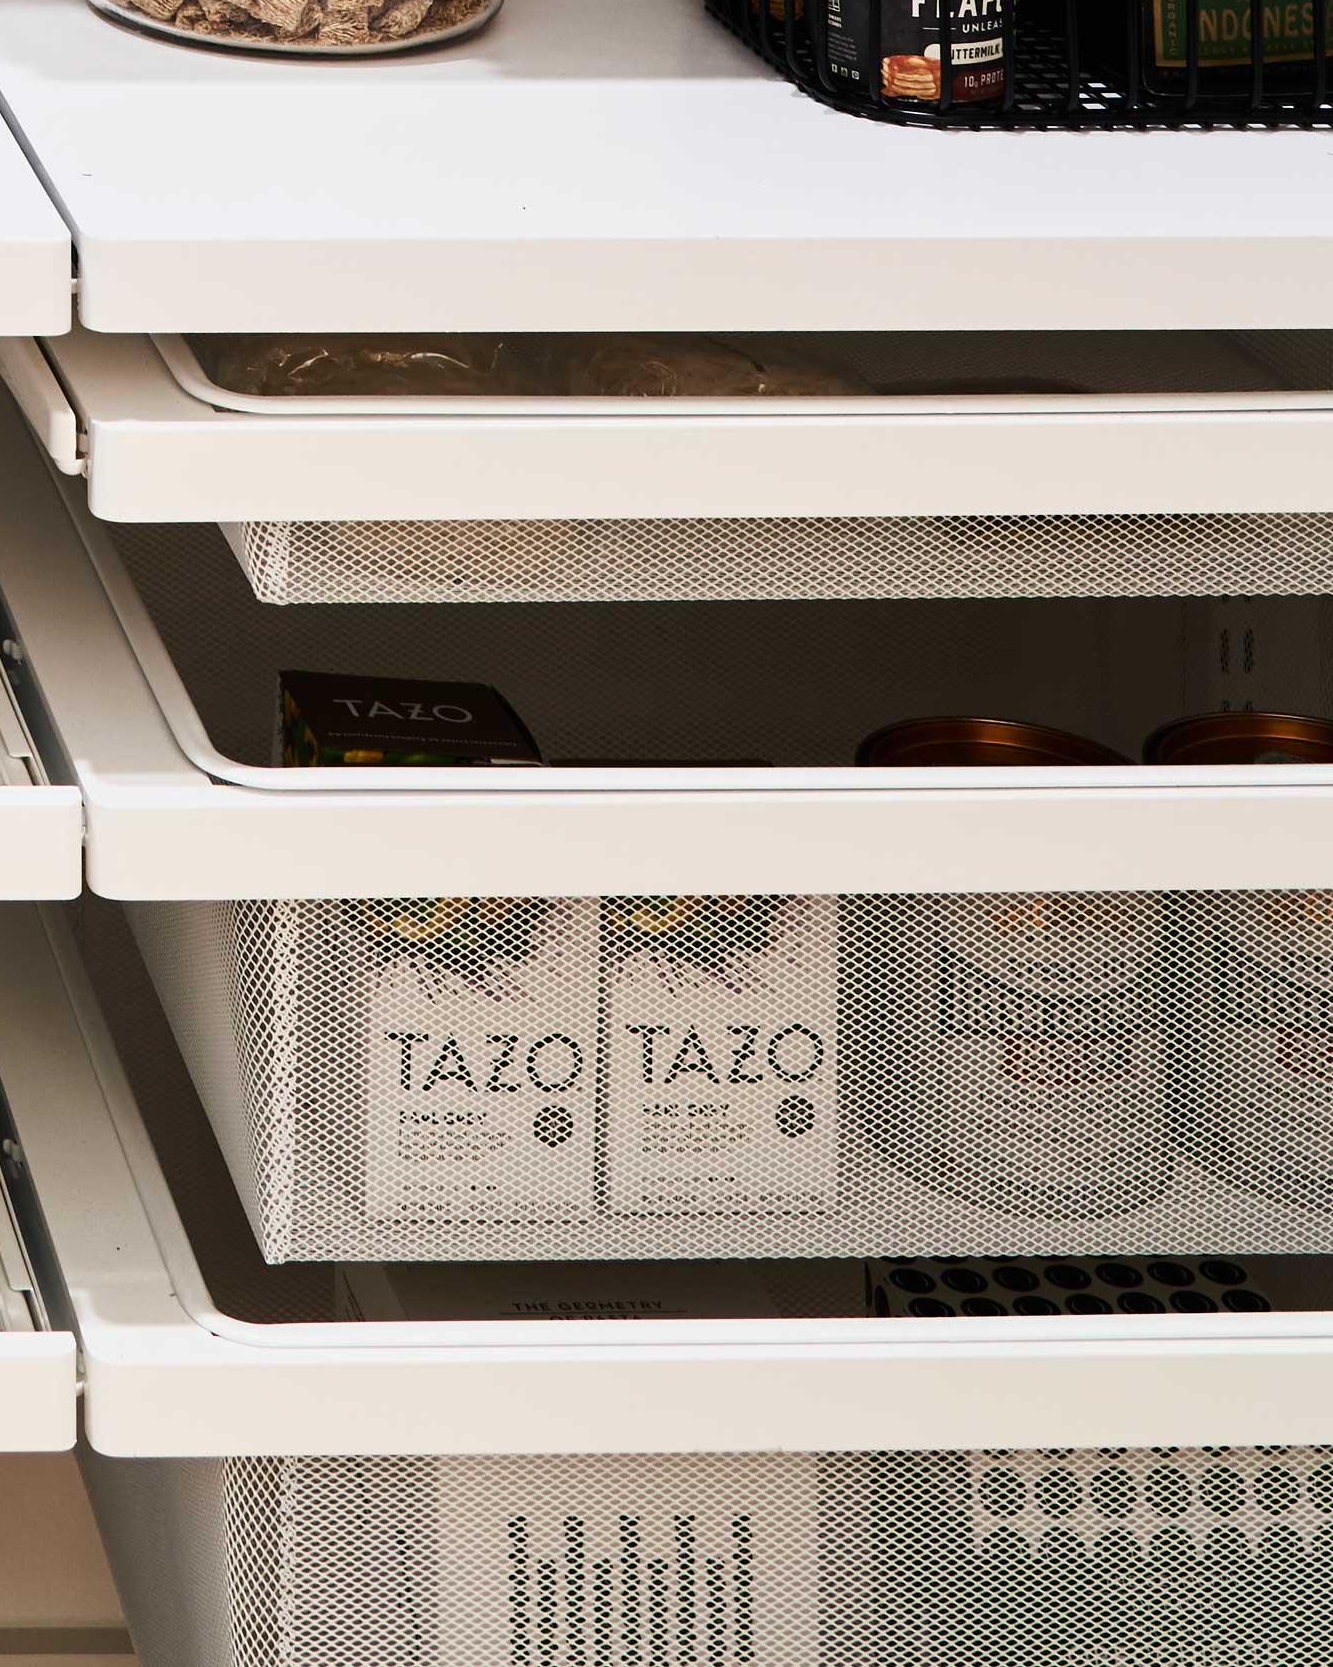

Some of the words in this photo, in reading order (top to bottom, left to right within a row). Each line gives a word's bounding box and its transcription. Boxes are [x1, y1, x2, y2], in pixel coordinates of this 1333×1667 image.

[332, 698, 473, 723] TAZO
[384, 1031, 584, 1093] TAZO
[624, 1023, 824, 1084] TAZO
[512, 1301, 551, 1312] THE
[559, 1300, 664, 1312] GEOMETRY
